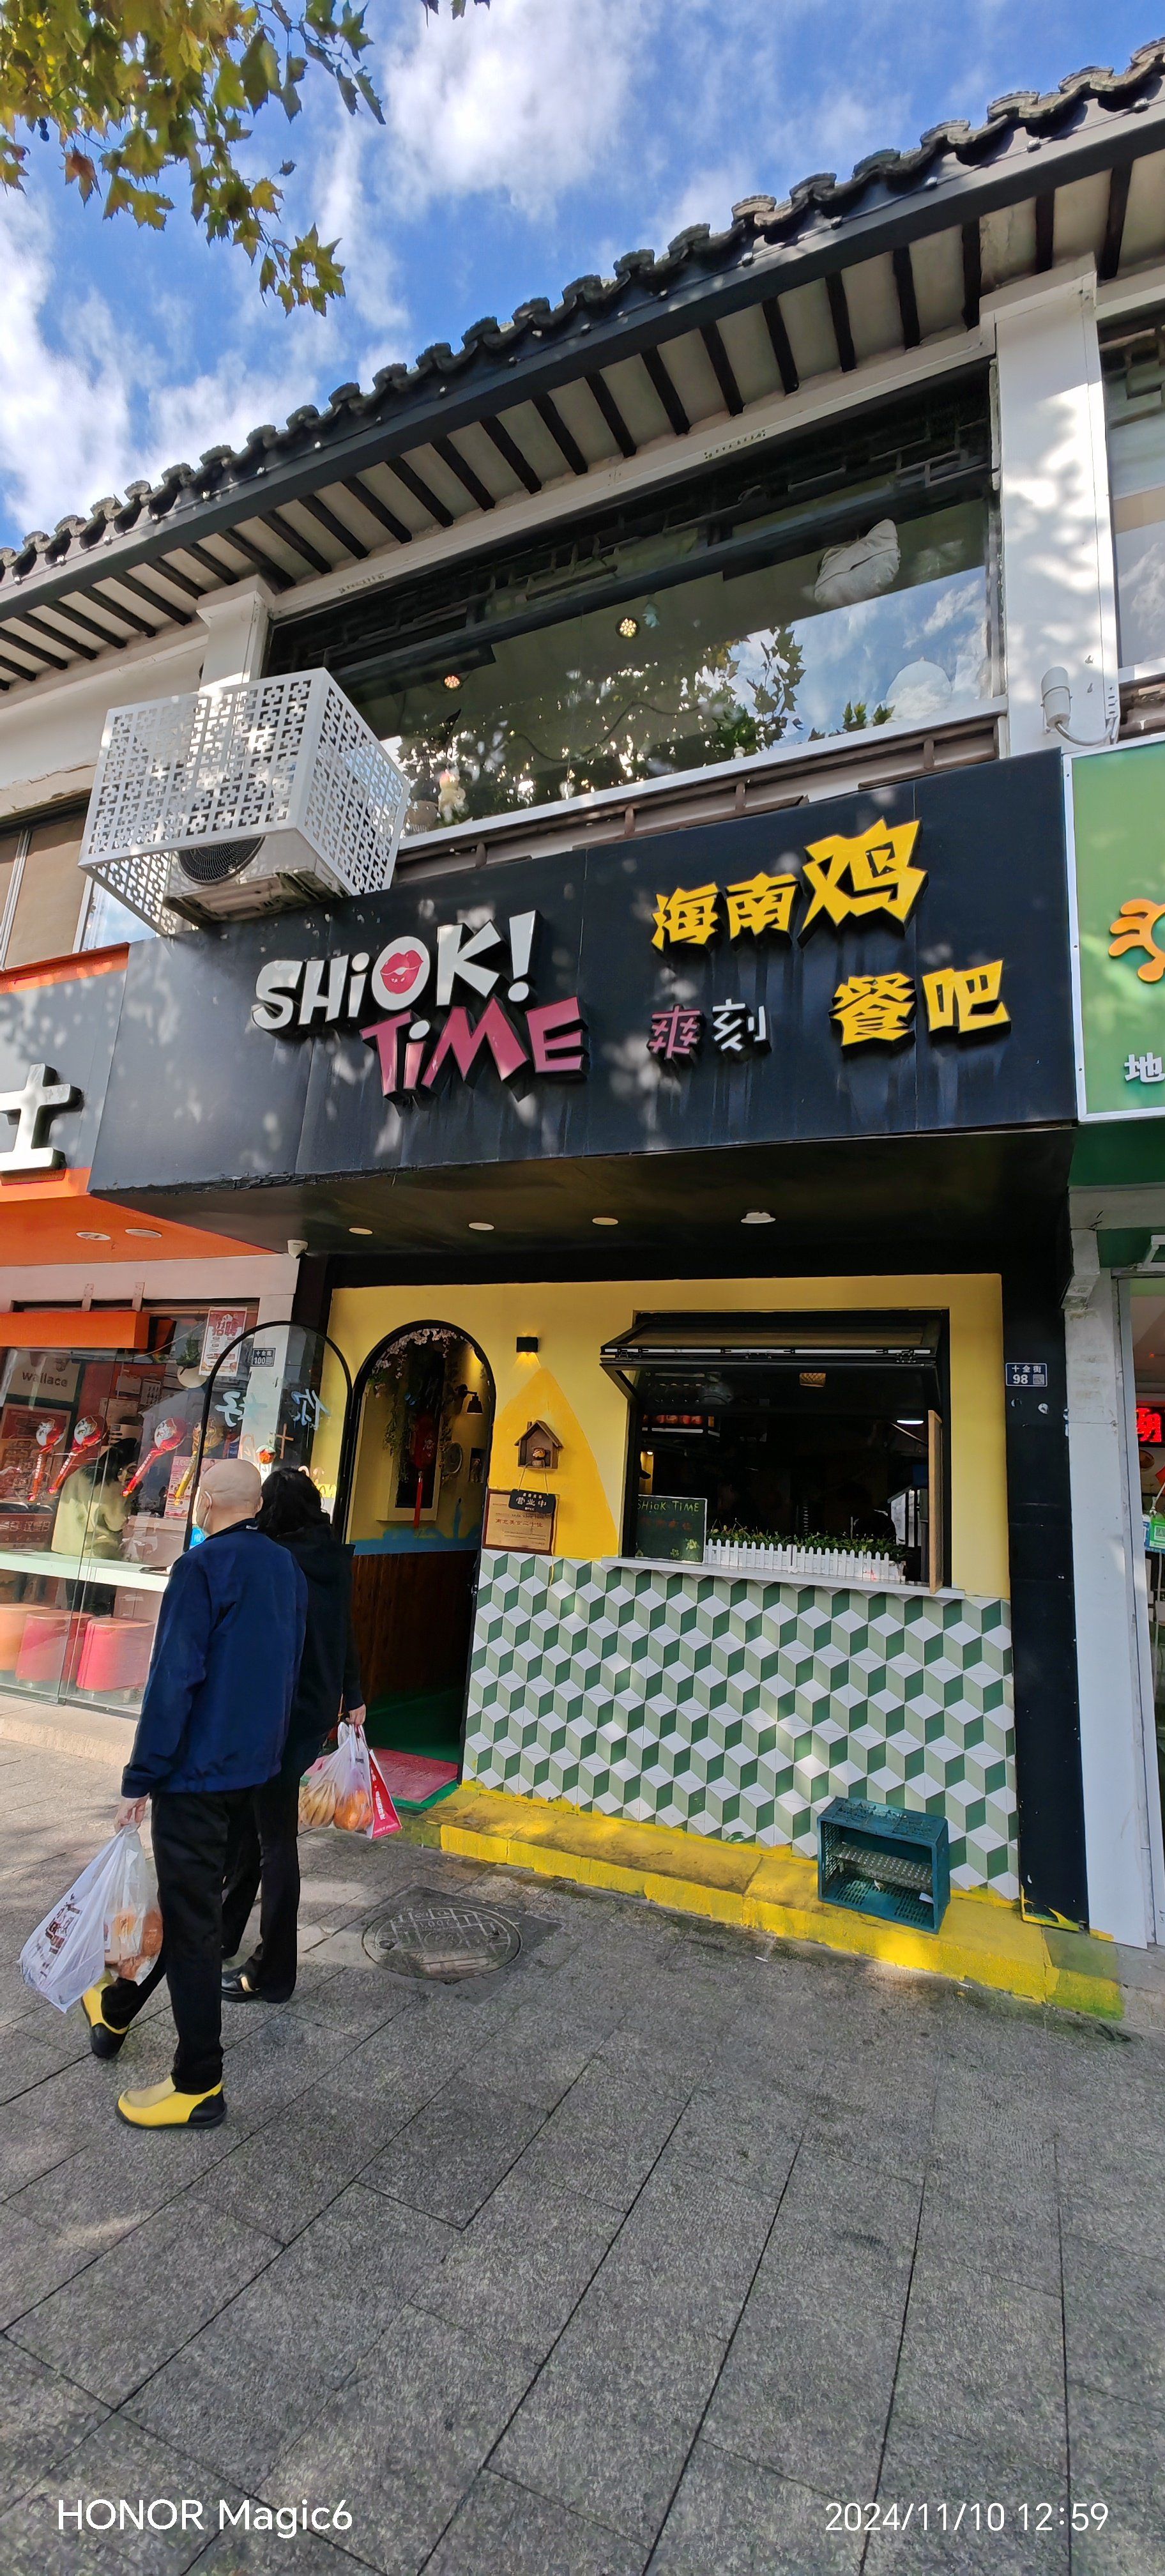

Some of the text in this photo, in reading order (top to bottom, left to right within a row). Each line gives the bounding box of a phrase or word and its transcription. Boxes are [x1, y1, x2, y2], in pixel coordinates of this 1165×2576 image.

[651, 817, 929, 951] 海南鸡
[830, 960, 1011, 1046] 餐吧
[647, 999, 766, 1059] 爽刻
[1124, 1052, 1165, 1082] 地
[1011, 1365, 1042, 1374] 十全街
[1012, 1374, 1028, 1384] 98
[515, 1496, 547, 1508] 营业中
